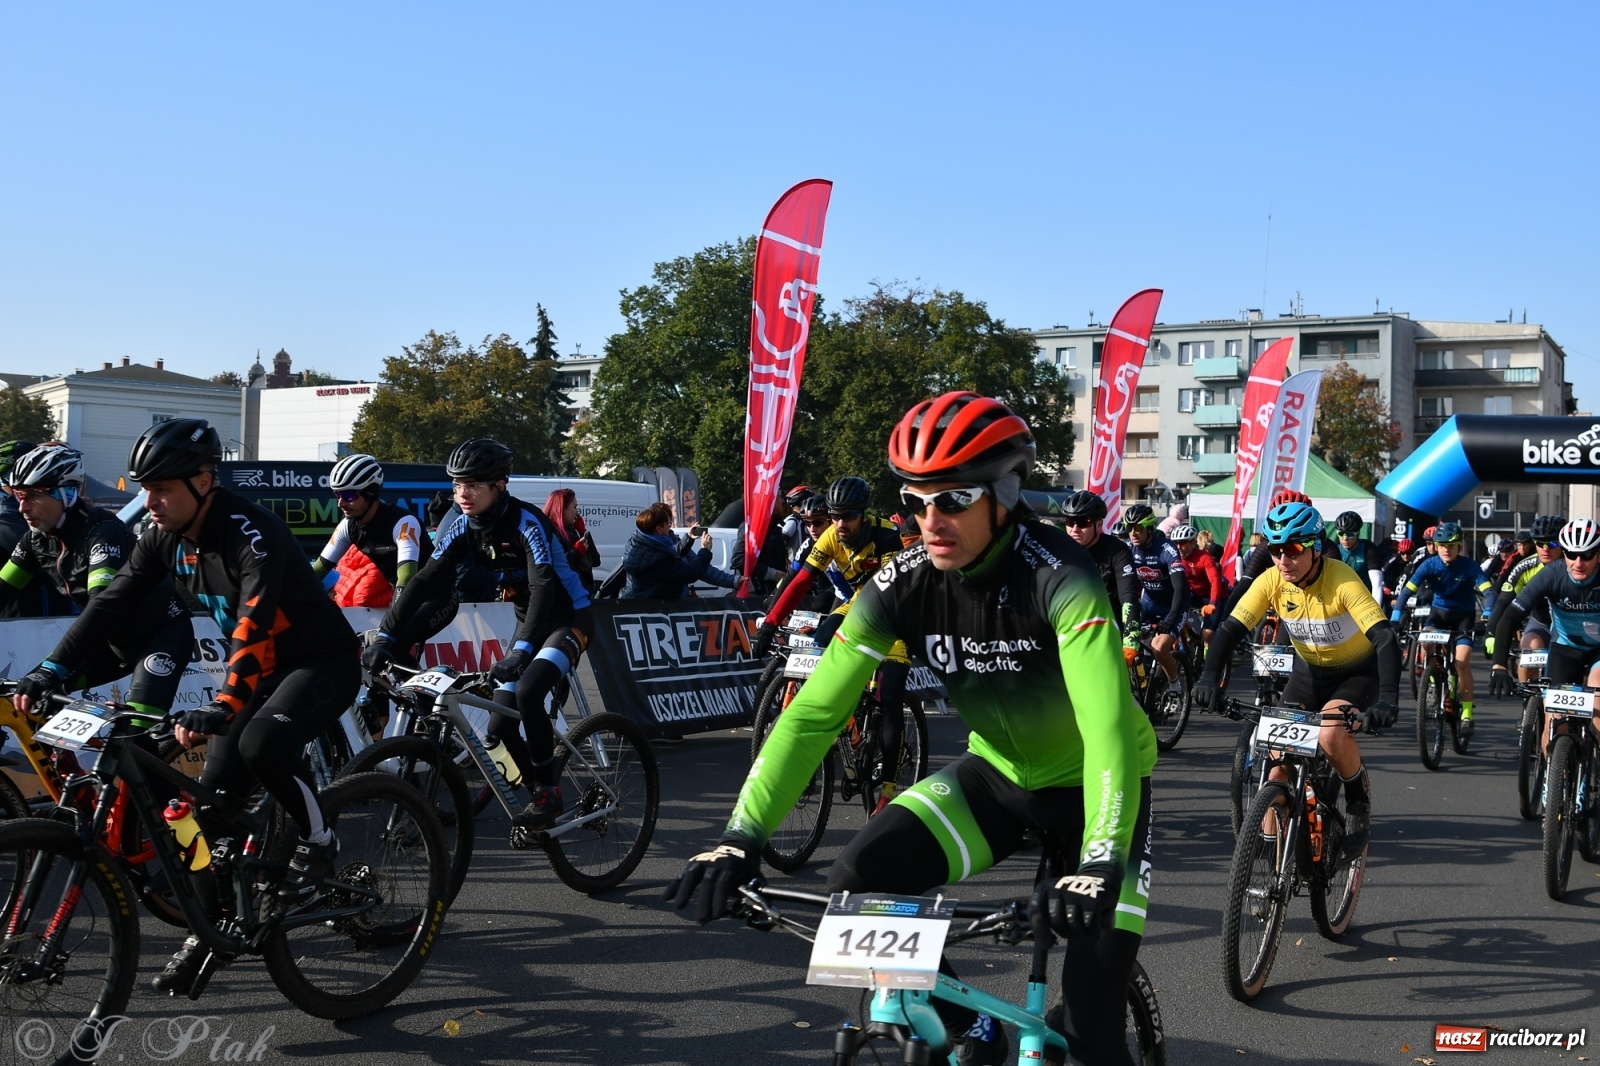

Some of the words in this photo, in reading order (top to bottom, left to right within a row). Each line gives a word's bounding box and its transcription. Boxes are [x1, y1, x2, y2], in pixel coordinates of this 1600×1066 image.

[1271, 391, 1305, 497] RACIB
[1523, 438, 1581, 465] bike
[273, 470, 312, 487] bike
[577, 506, 643, 518] ajpotężniejszy
[1566, 601, 1600, 609] SutriSe
[615, 613, 757, 668] TREZA
[794, 639, 815, 648] 318
[960, 636, 1042, 655] Kaczmarek
[964, 657, 1023, 674] electric
[648, 686, 744, 722] USZCZELNIAMY
[1553, 694, 1585, 706] 2823
[52, 717, 93, 736] 2578
[1269, 723, 1311, 741] 2237
[1093, 769, 1112, 836] Kaczmarek
[1107, 790, 1123, 835] electric
[836, 928, 921, 959] 1424
[1135, 974, 1164, 1045] KENDA
